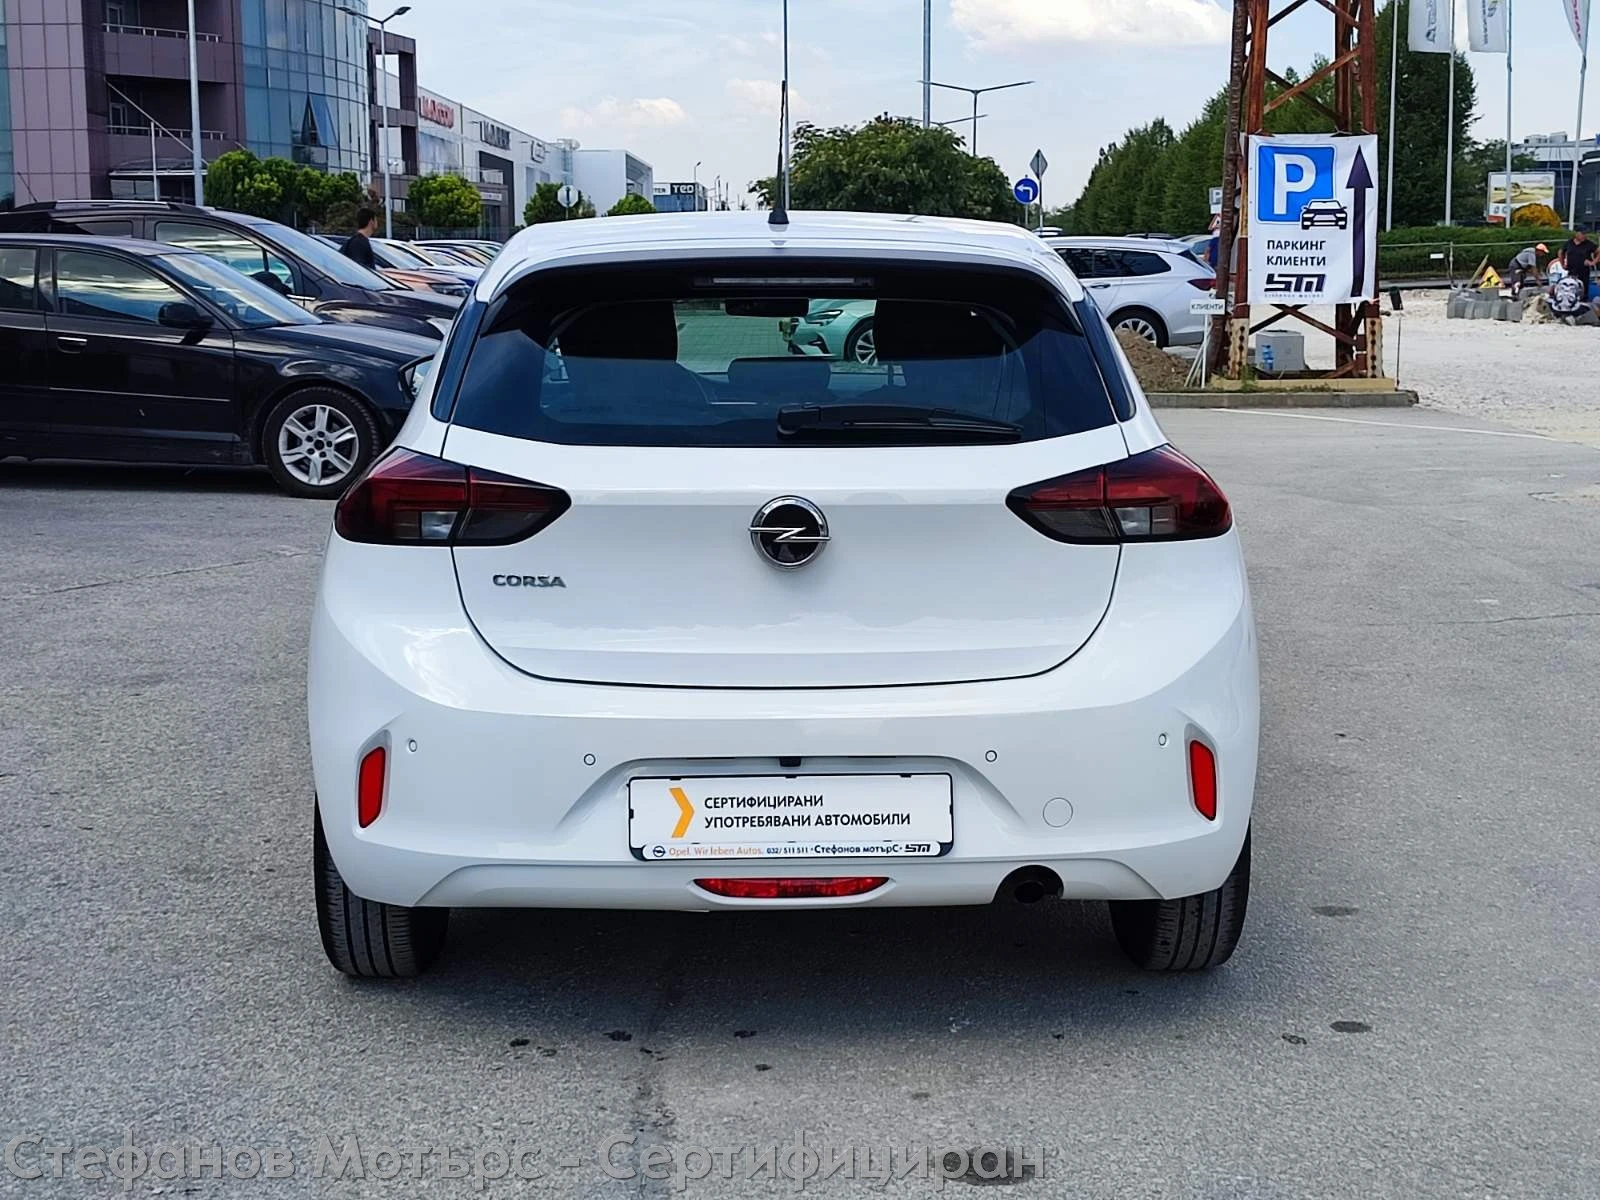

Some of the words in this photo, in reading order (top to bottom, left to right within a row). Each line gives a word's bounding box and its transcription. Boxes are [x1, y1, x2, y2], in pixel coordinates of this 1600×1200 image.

[1273, 153, 1317, 215] P
[1266, 239, 1327, 251] ПАРКИНГ
[1266, 255, 1326, 267] КЛИЕНТИ
[1191, 302, 1224, 311] КЛИЕНТИ
[492, 574, 567, 588] CORSA
[704, 794, 824, 810] СЕРТИФИЦИРАНИ
[704, 814, 811, 829] УПОТРЕБЯВАНИ
[814, 812, 911, 827] АВТОМОБИЛИ
